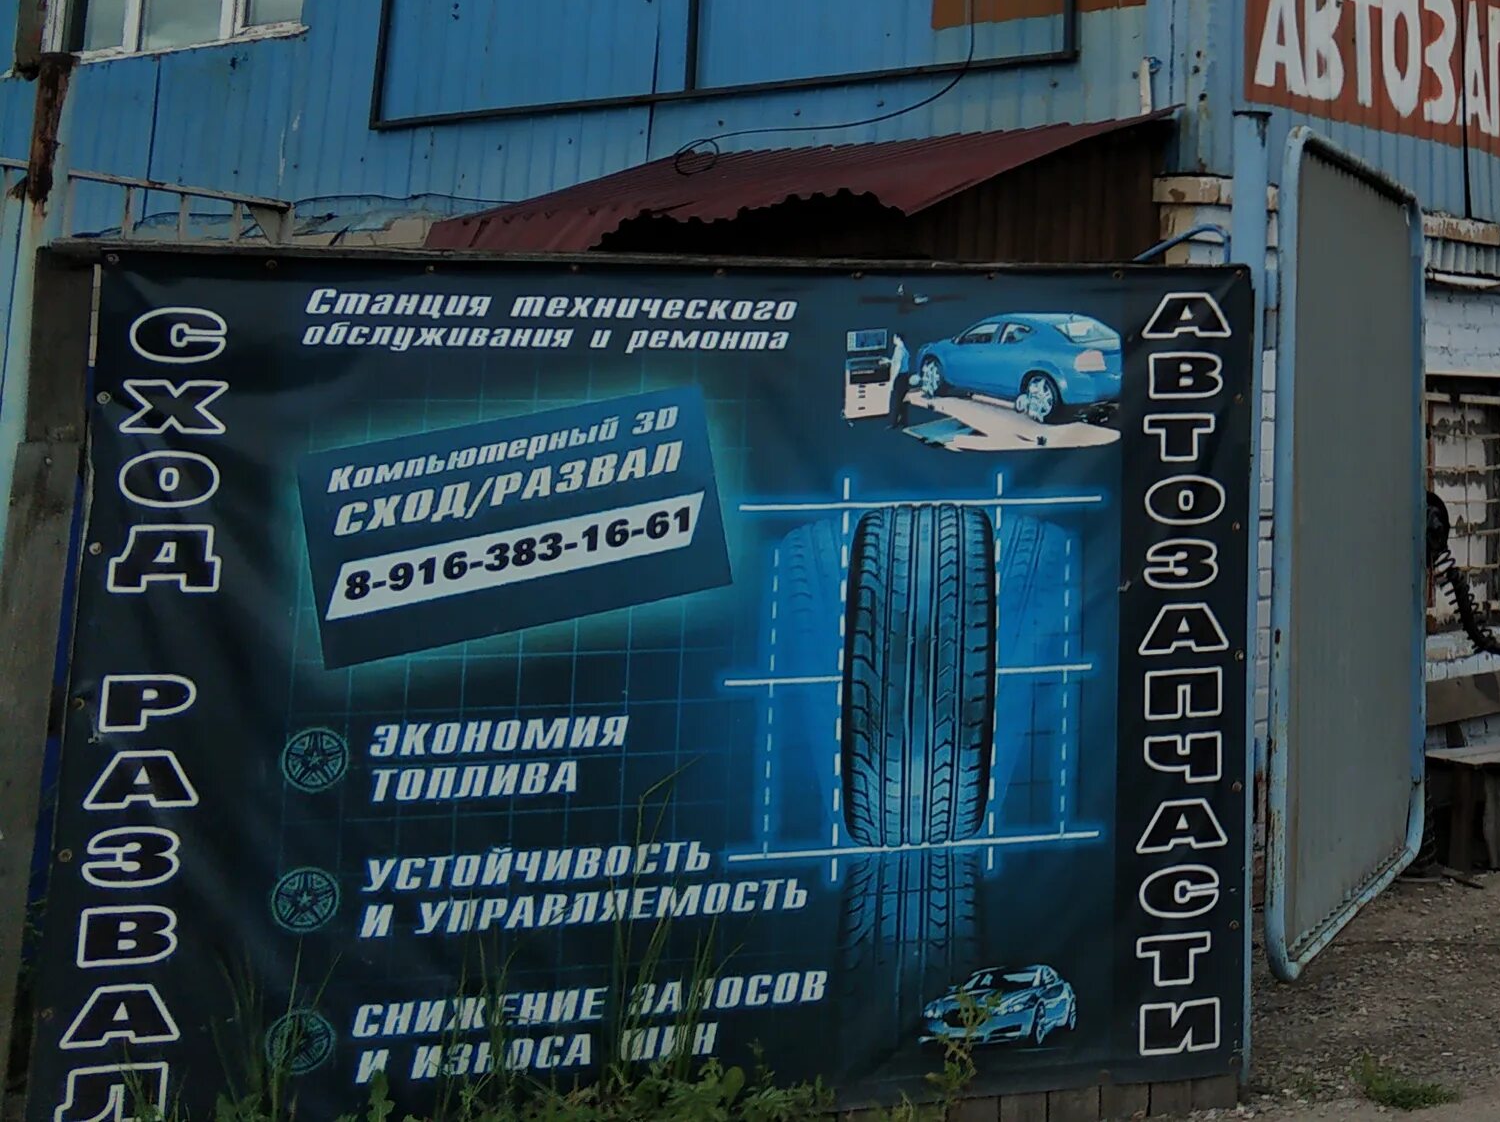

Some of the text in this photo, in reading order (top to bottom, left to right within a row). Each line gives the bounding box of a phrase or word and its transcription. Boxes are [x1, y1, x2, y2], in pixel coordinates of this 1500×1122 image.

[305, 288, 798, 321] Станция технического
[302, 321, 790, 354] обслуживания и ремонта
[107, 306, 229, 594] СХОД
[326, 405, 679, 494] Компьютерный 3D
[333, 440, 684, 537] СХОД/РАЗВАЛ
[344, 506, 691, 601] 8-916-383-16-61
[1135, 291, 1232, 1058] АВТОЗАПЧАСТИ
[370, 715, 629, 757] ЭКОНОМИЯ
[371, 760, 578, 803] ТОПЛИВА
[361, 841, 710, 893] УСТОЙЧИВОСТЬ
[359, 878, 808, 938] И УПРАВЛЯЕМОСТЬ
[352, 985, 610, 1039] СНИЖЕНИЕ
[355, 1048, 390, 1084] И
